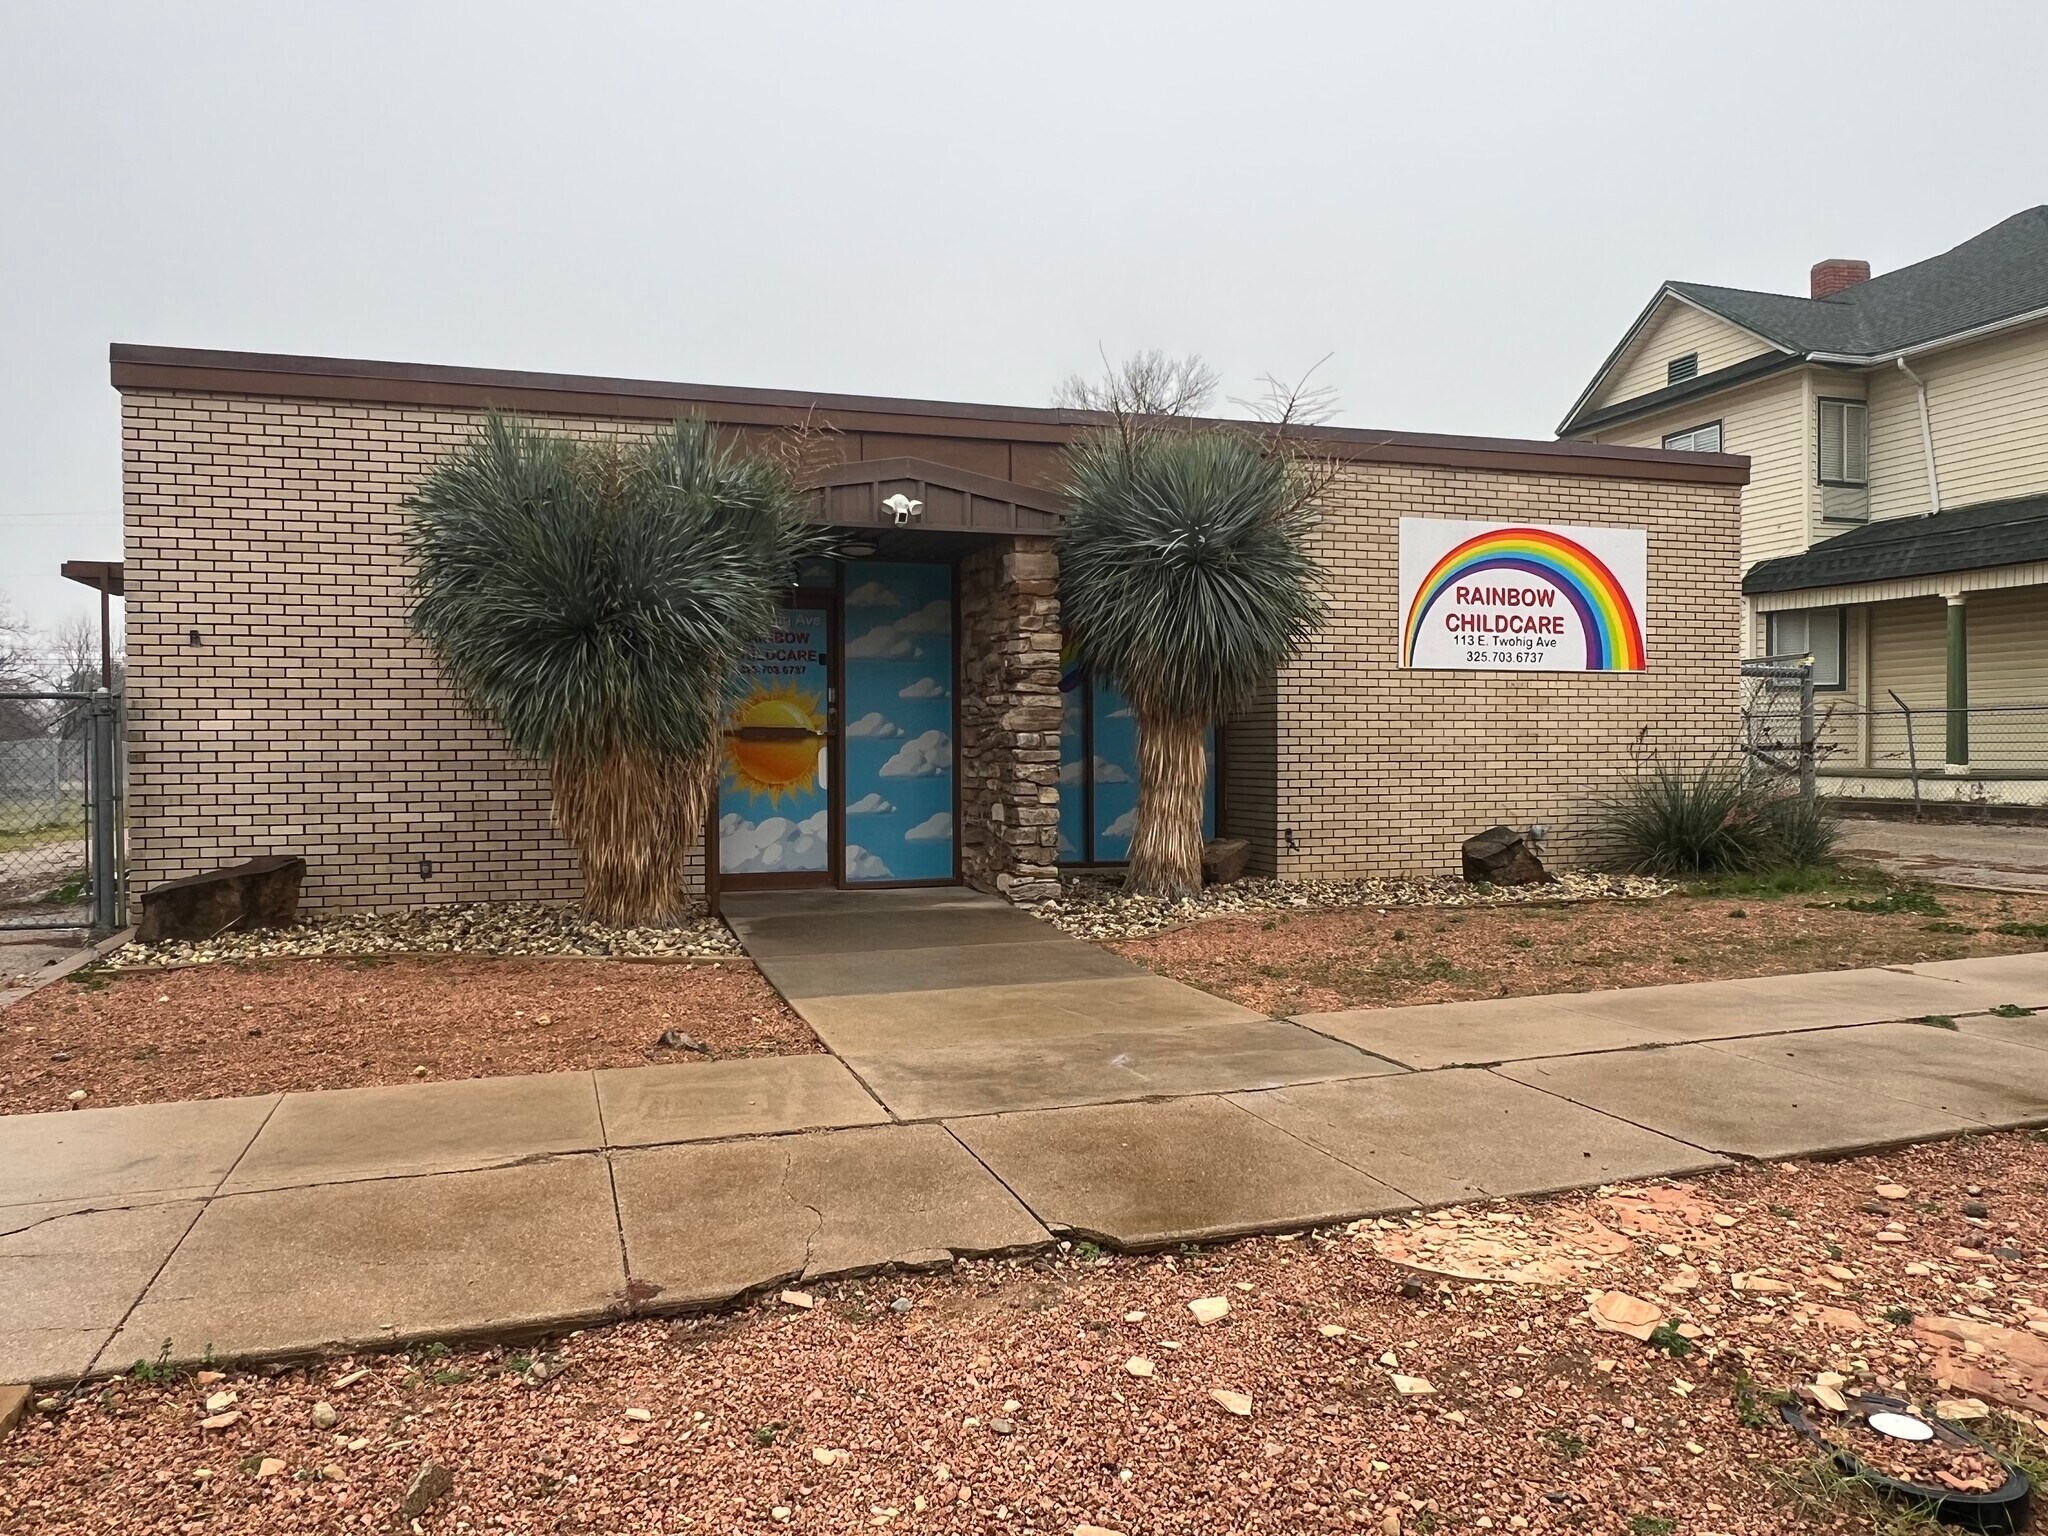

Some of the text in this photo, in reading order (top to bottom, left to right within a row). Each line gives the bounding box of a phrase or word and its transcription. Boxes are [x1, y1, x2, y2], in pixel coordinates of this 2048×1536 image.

[1456, 586, 1555, 608] RAINBOW
[795, 613, 822, 626] Ave
[1445, 613, 1565, 635] CHILDCARE
[1453, 635, 1557, 650] 113 E. Twohig Ave
[1466, 651, 1544, 663] 325.703.6737
